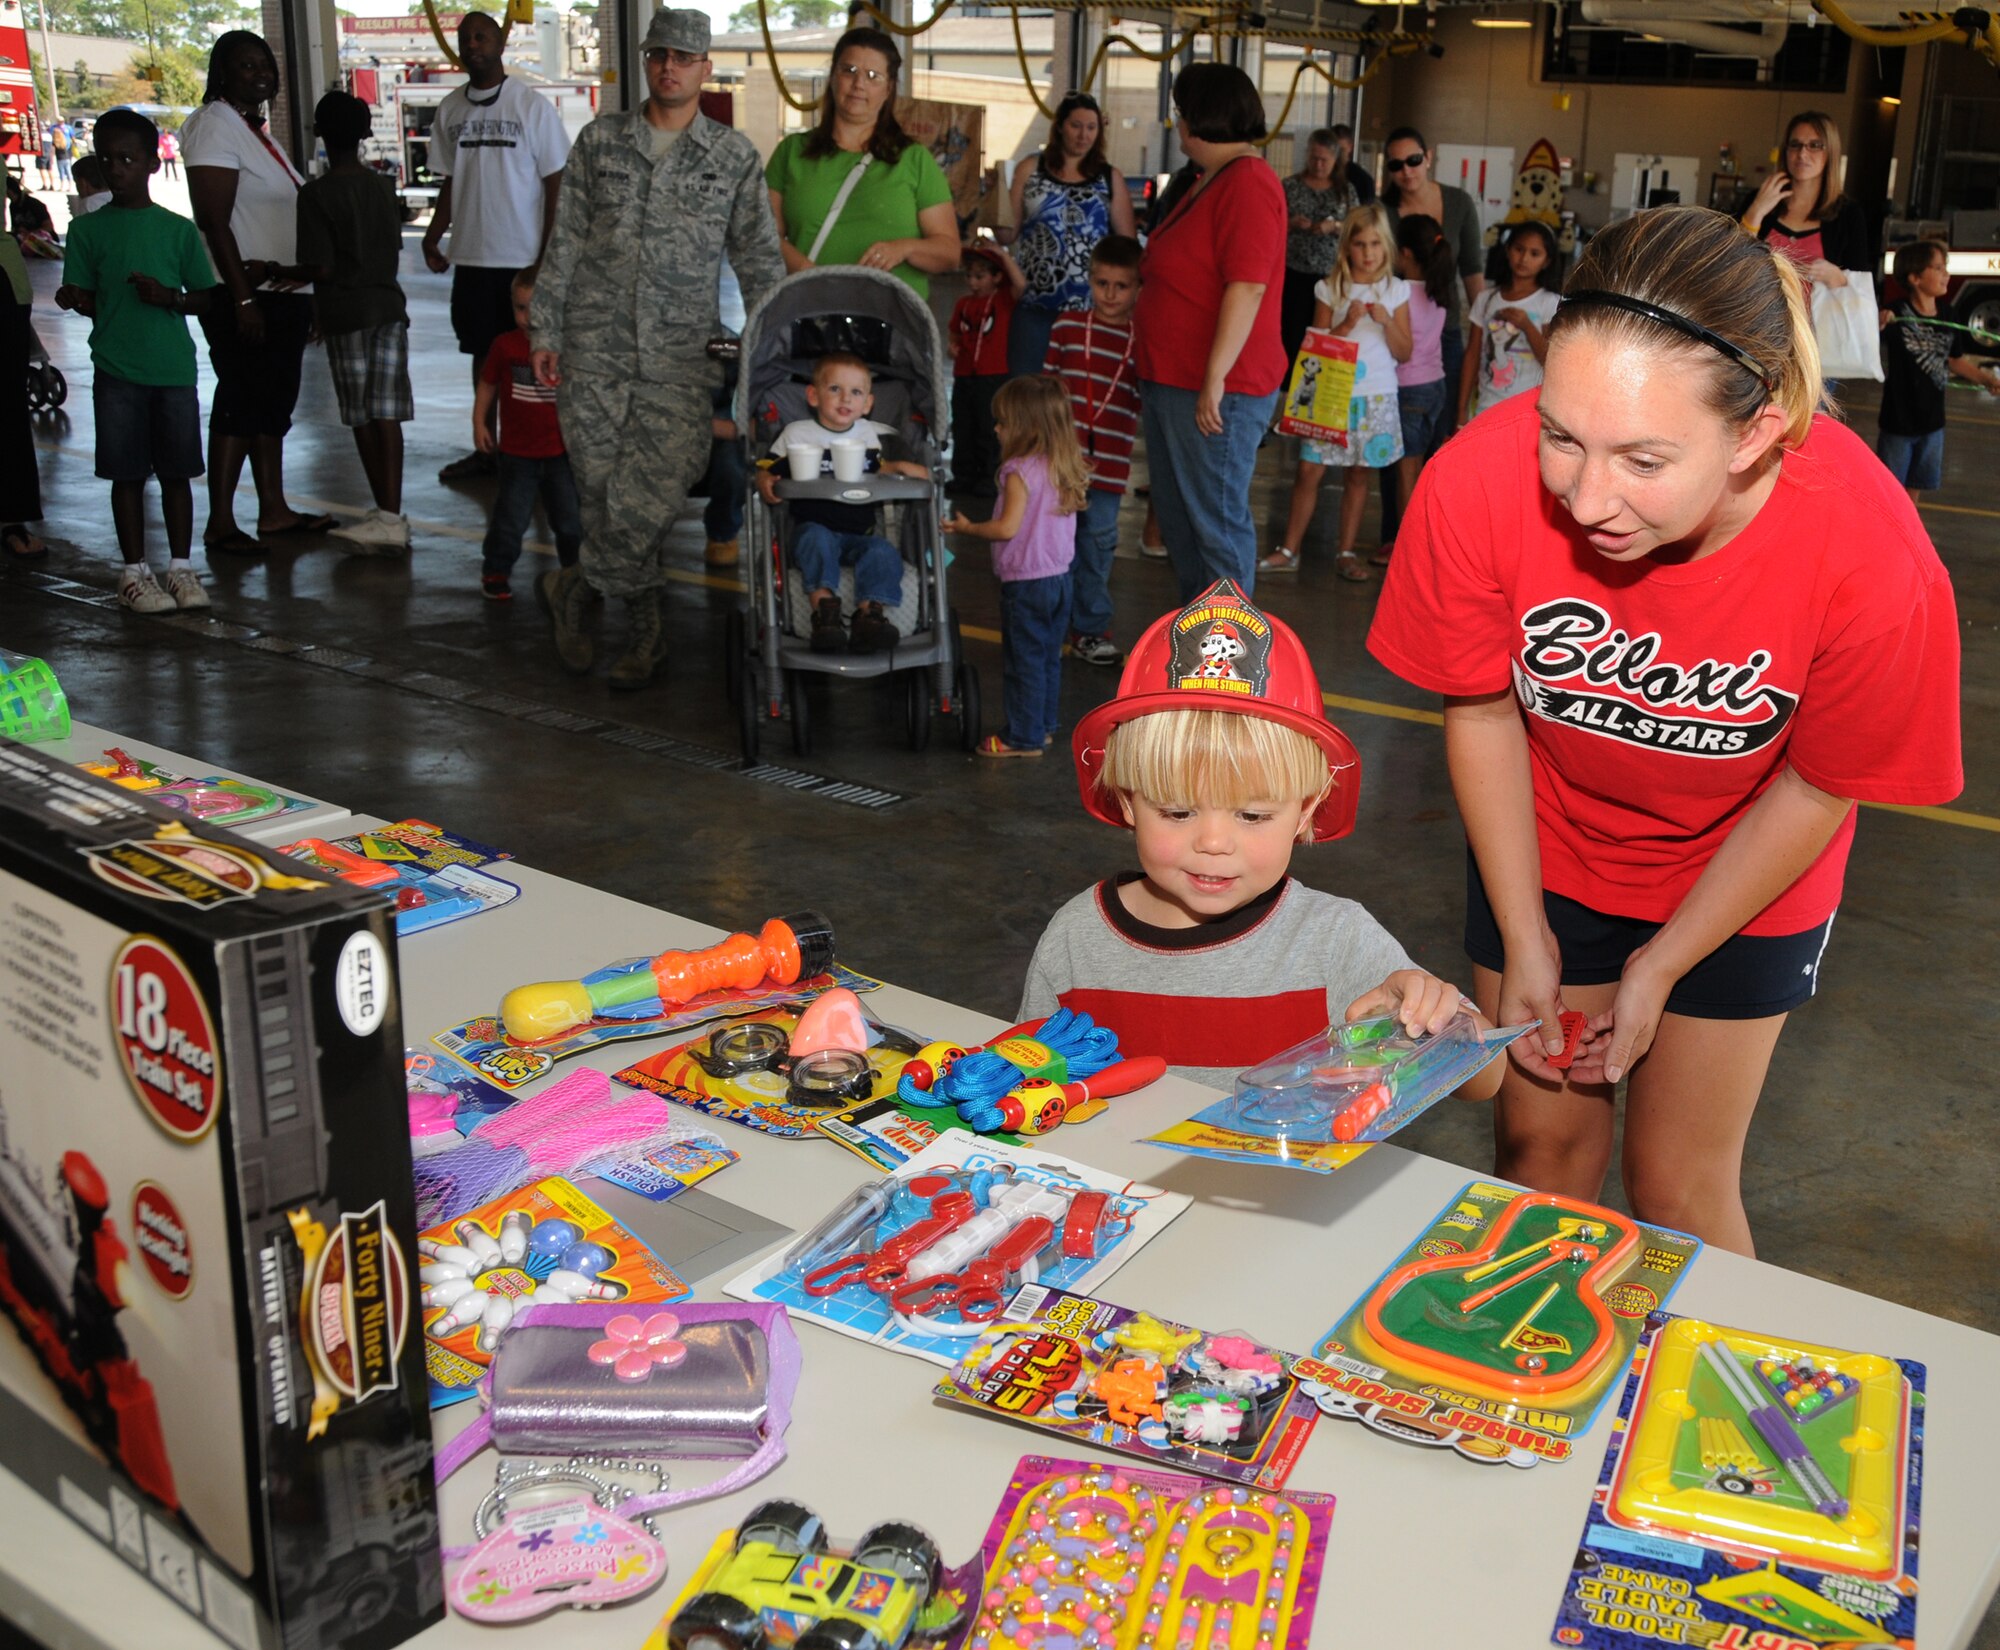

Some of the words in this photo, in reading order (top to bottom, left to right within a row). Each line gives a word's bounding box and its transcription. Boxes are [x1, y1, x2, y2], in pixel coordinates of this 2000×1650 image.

[355, 17, 394, 30] KEESLER
[397, 17, 417, 30] FIRE
[420, 16, 458, 29] RECUE
[1179, 608, 1212, 633] JUNIOR
[1212, 607, 1267, 637] FIREFIGHTER
[1521, 597, 1777, 716] Biloxi
[1181, 679, 1203, 690] WHEN
[1203, 679, 1219, 690] FIRE
[1220, 679, 1251, 694] STRIKES
[1560, 700, 1748, 751] ALL-STARS
[357, 948, 374, 1018] EZTEC
[118, 965, 167, 1052] 18
[167, 1028, 214, 1074] Piece
[130, 1046, 174, 1095] Train
[1019, 1053, 1042, 1068] REAL
[882, 1127, 926, 1154] ump
[608, 1167, 661, 1191] SPLASH
[352, 1231, 382, 1296] Forty
[1640, 1262, 1673, 1274] TEST
[1643, 1254, 1682, 1268] YOUR
[1644, 1247, 1687, 1262] SKILLS!
[260, 1247, 282, 1326] BATTERY
[320, 1282, 345, 1353] SPECIAL
[1041, 1320, 1059, 1332] 4
[1050, 1297, 1081, 1323] Sky
[1059, 1301, 1098, 1338] Divers
[359, 1296, 391, 1370] Niner
[270, 1335, 292, 1425] OPERATED
[974, 1332, 1042, 1402] RADICAL
[995, 1336, 1072, 1412] SKY
[497, 1543, 615, 1572] Accessories
[558, 1557, 617, 1575] Purse
[498, 1566, 547, 1588] with
[1601, 1564, 1693, 1597] GAME
[1578, 1577, 1703, 1621] TABLE
[1837, 1590, 1877, 1611] TABLE
[1590, 1605, 1687, 1643] POOL
